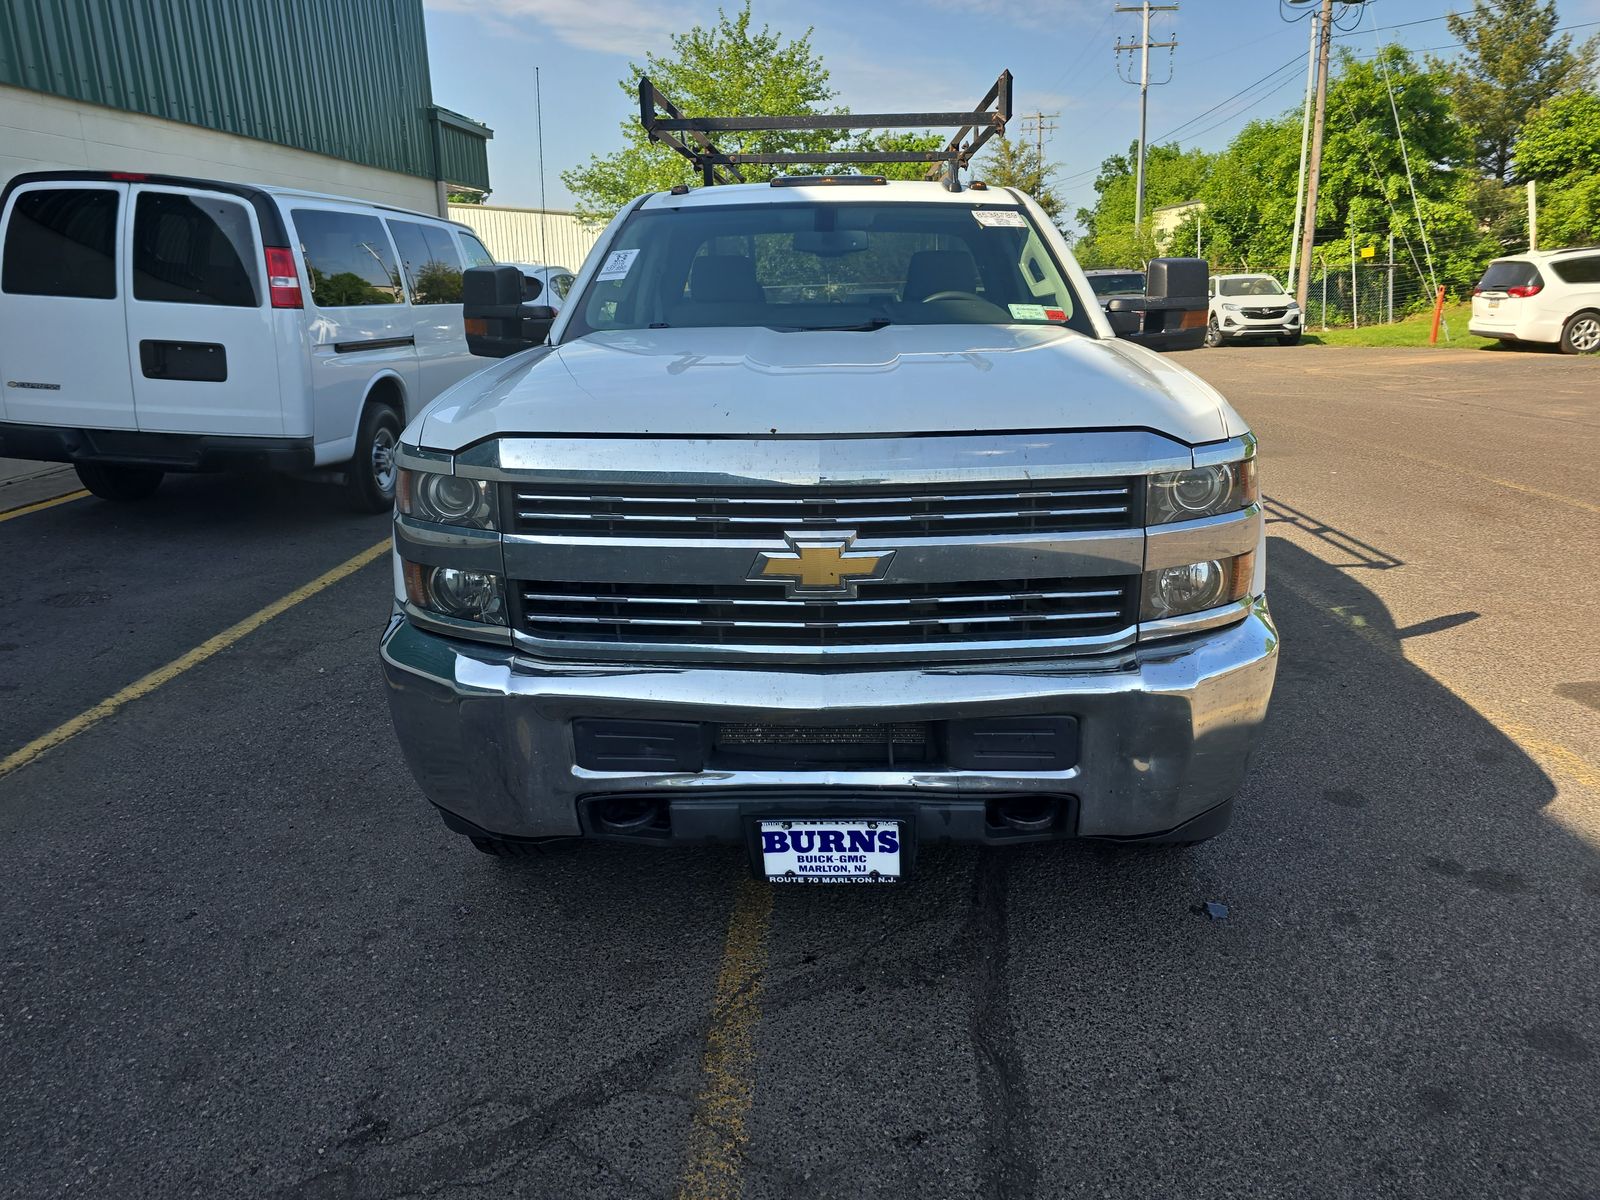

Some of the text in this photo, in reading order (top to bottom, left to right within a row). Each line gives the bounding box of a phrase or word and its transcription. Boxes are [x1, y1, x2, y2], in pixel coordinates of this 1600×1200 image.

[761, 830, 899, 853] BURNS
[797, 855, 867, 863] BUICK-GMC
[798, 865, 851, 873] MARLTON,
